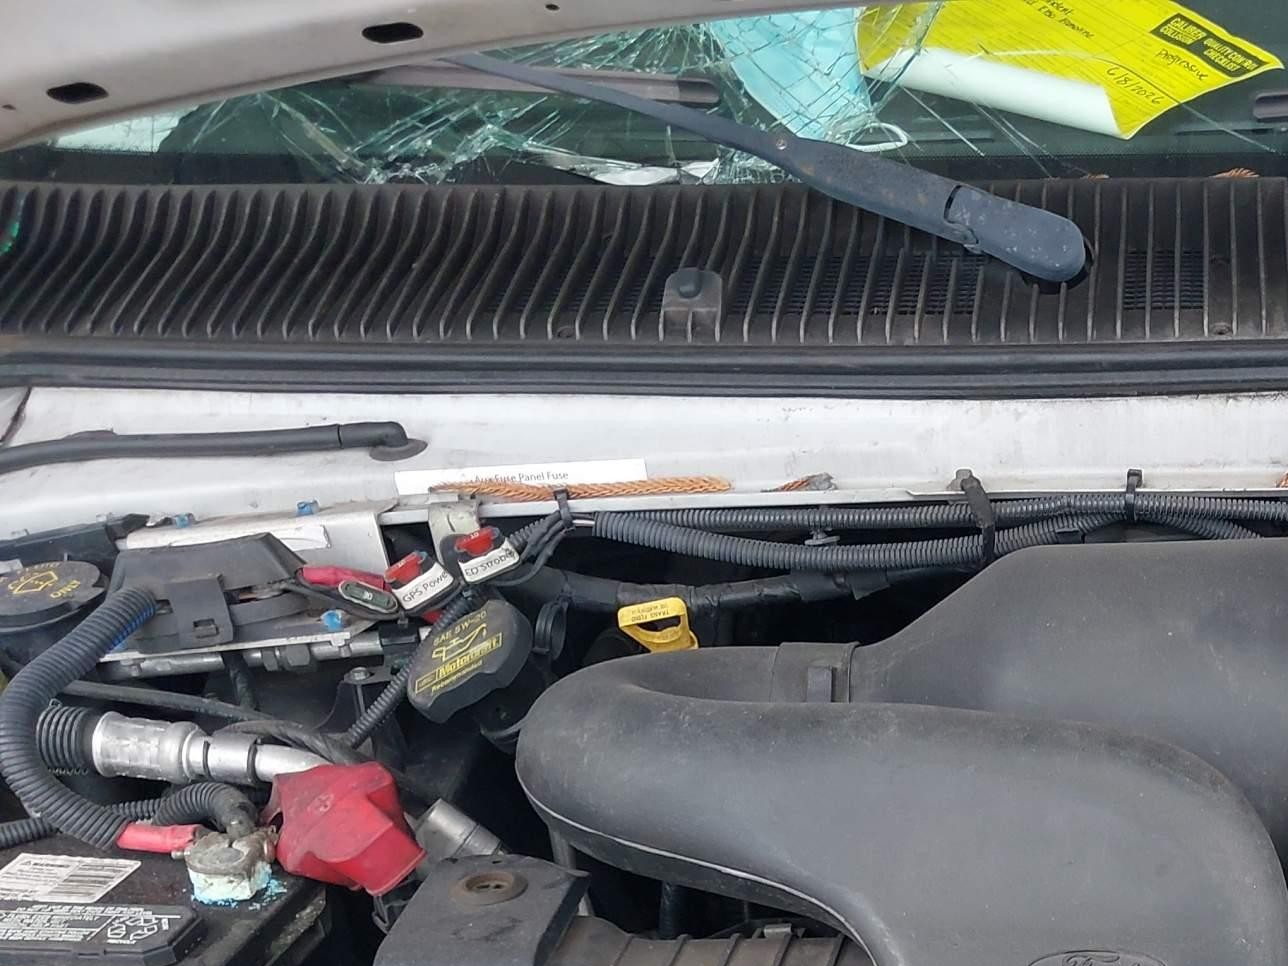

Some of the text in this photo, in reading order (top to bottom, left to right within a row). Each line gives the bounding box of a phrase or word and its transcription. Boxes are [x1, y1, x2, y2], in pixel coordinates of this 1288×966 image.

[1159, 26, 1195, 45] COLLISION
[1170, 17, 1207, 38] CALIBER
[1203, 38, 1230, 54] QUALITY
[1203, 48, 1241, 72] CHECKLIST
[518, 472, 545, 483] Panel
[546, 471, 569, 481] Fuse
[465, 566, 479, 576] ED
[402, 570, 448, 602] GPS Powe
[438, 634, 498, 680] Motorcraft
